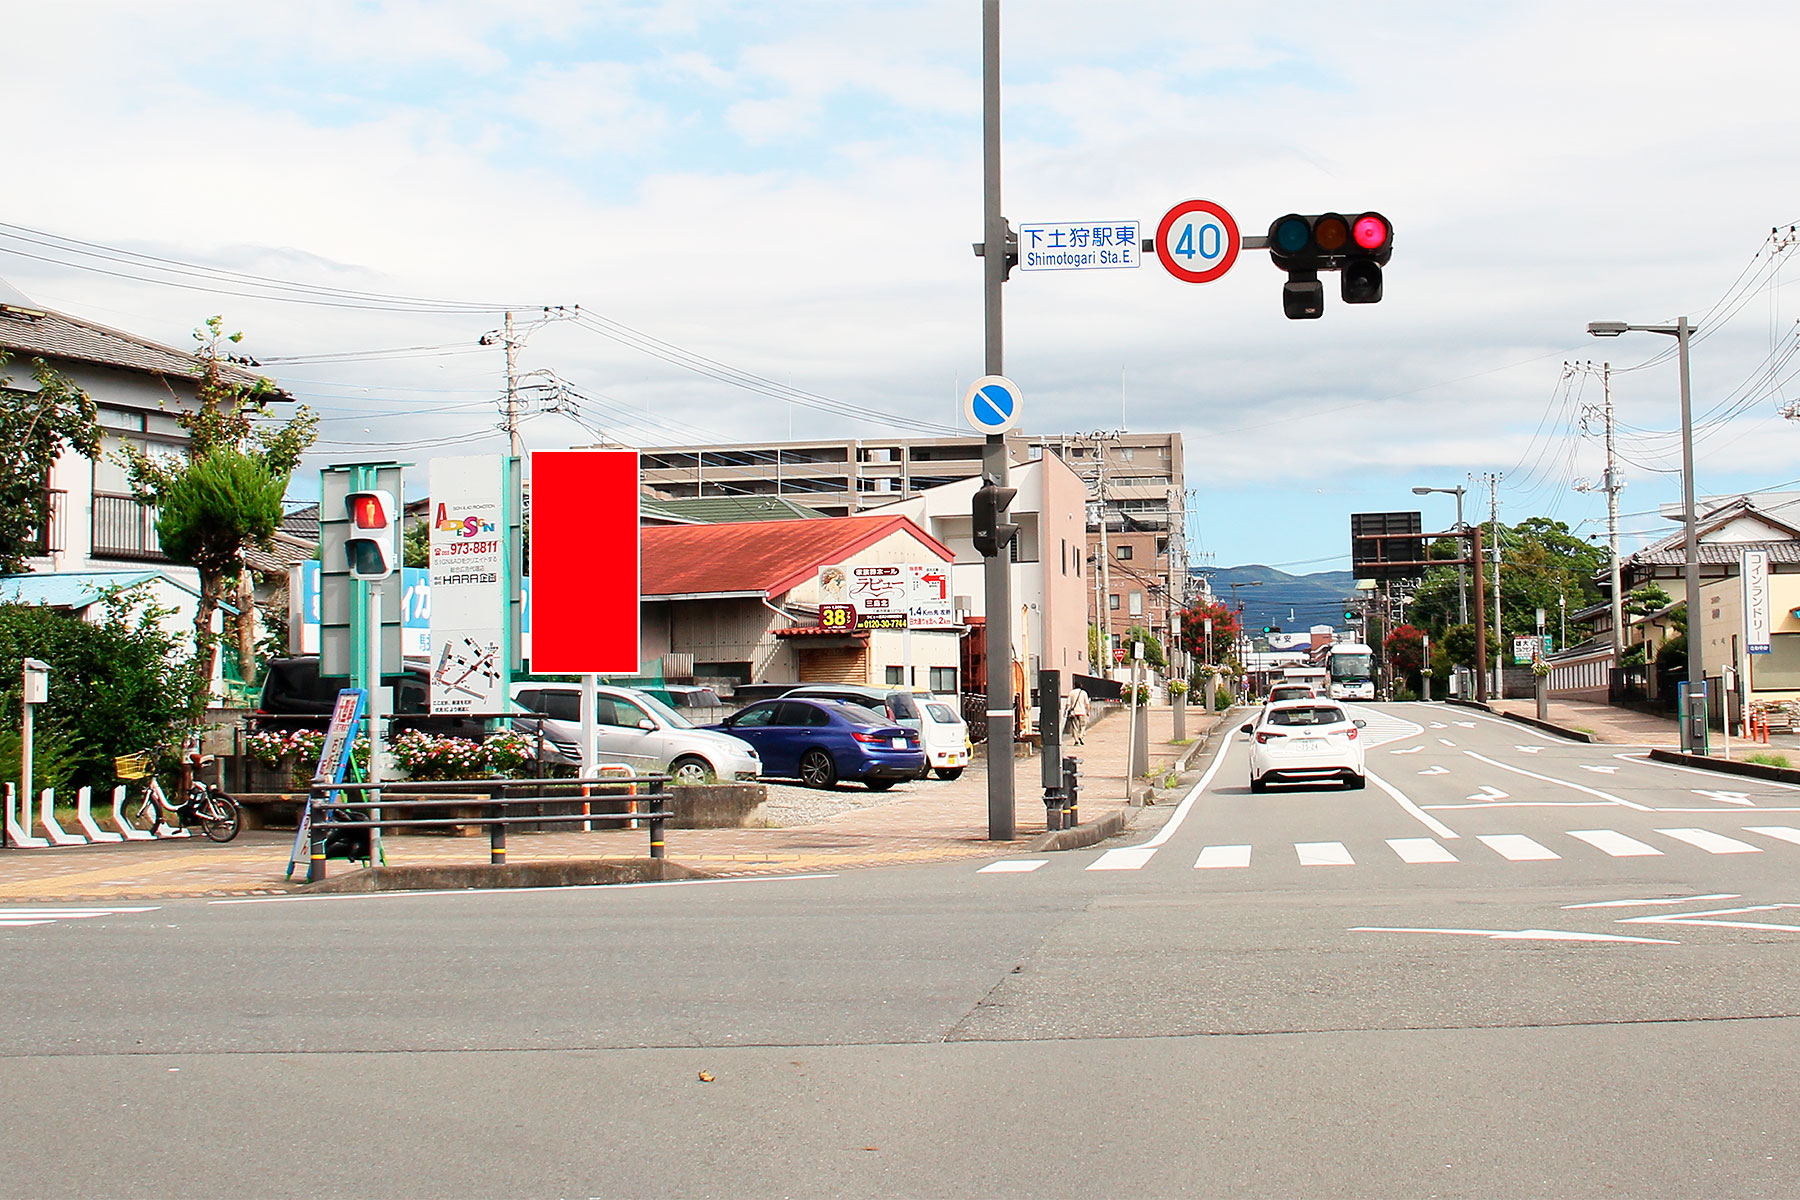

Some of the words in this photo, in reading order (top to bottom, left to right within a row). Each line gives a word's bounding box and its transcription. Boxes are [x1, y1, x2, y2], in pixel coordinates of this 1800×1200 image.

[1024, 225, 1137, 249] 下土狩駅東
[1175, 223, 1221, 260] 40
[1027, 252, 1096, 268] Shimotogari
[852, 577, 905, 594] ラビュー
[866, 599, 889, 607] 三島北
[1751, 554, 1764, 642] コインランドリー
[823, 610, 846, 627] 38
[864, 618, 907, 629] 0120-30-7744
[1274, 635, 1292, 643] 平安
